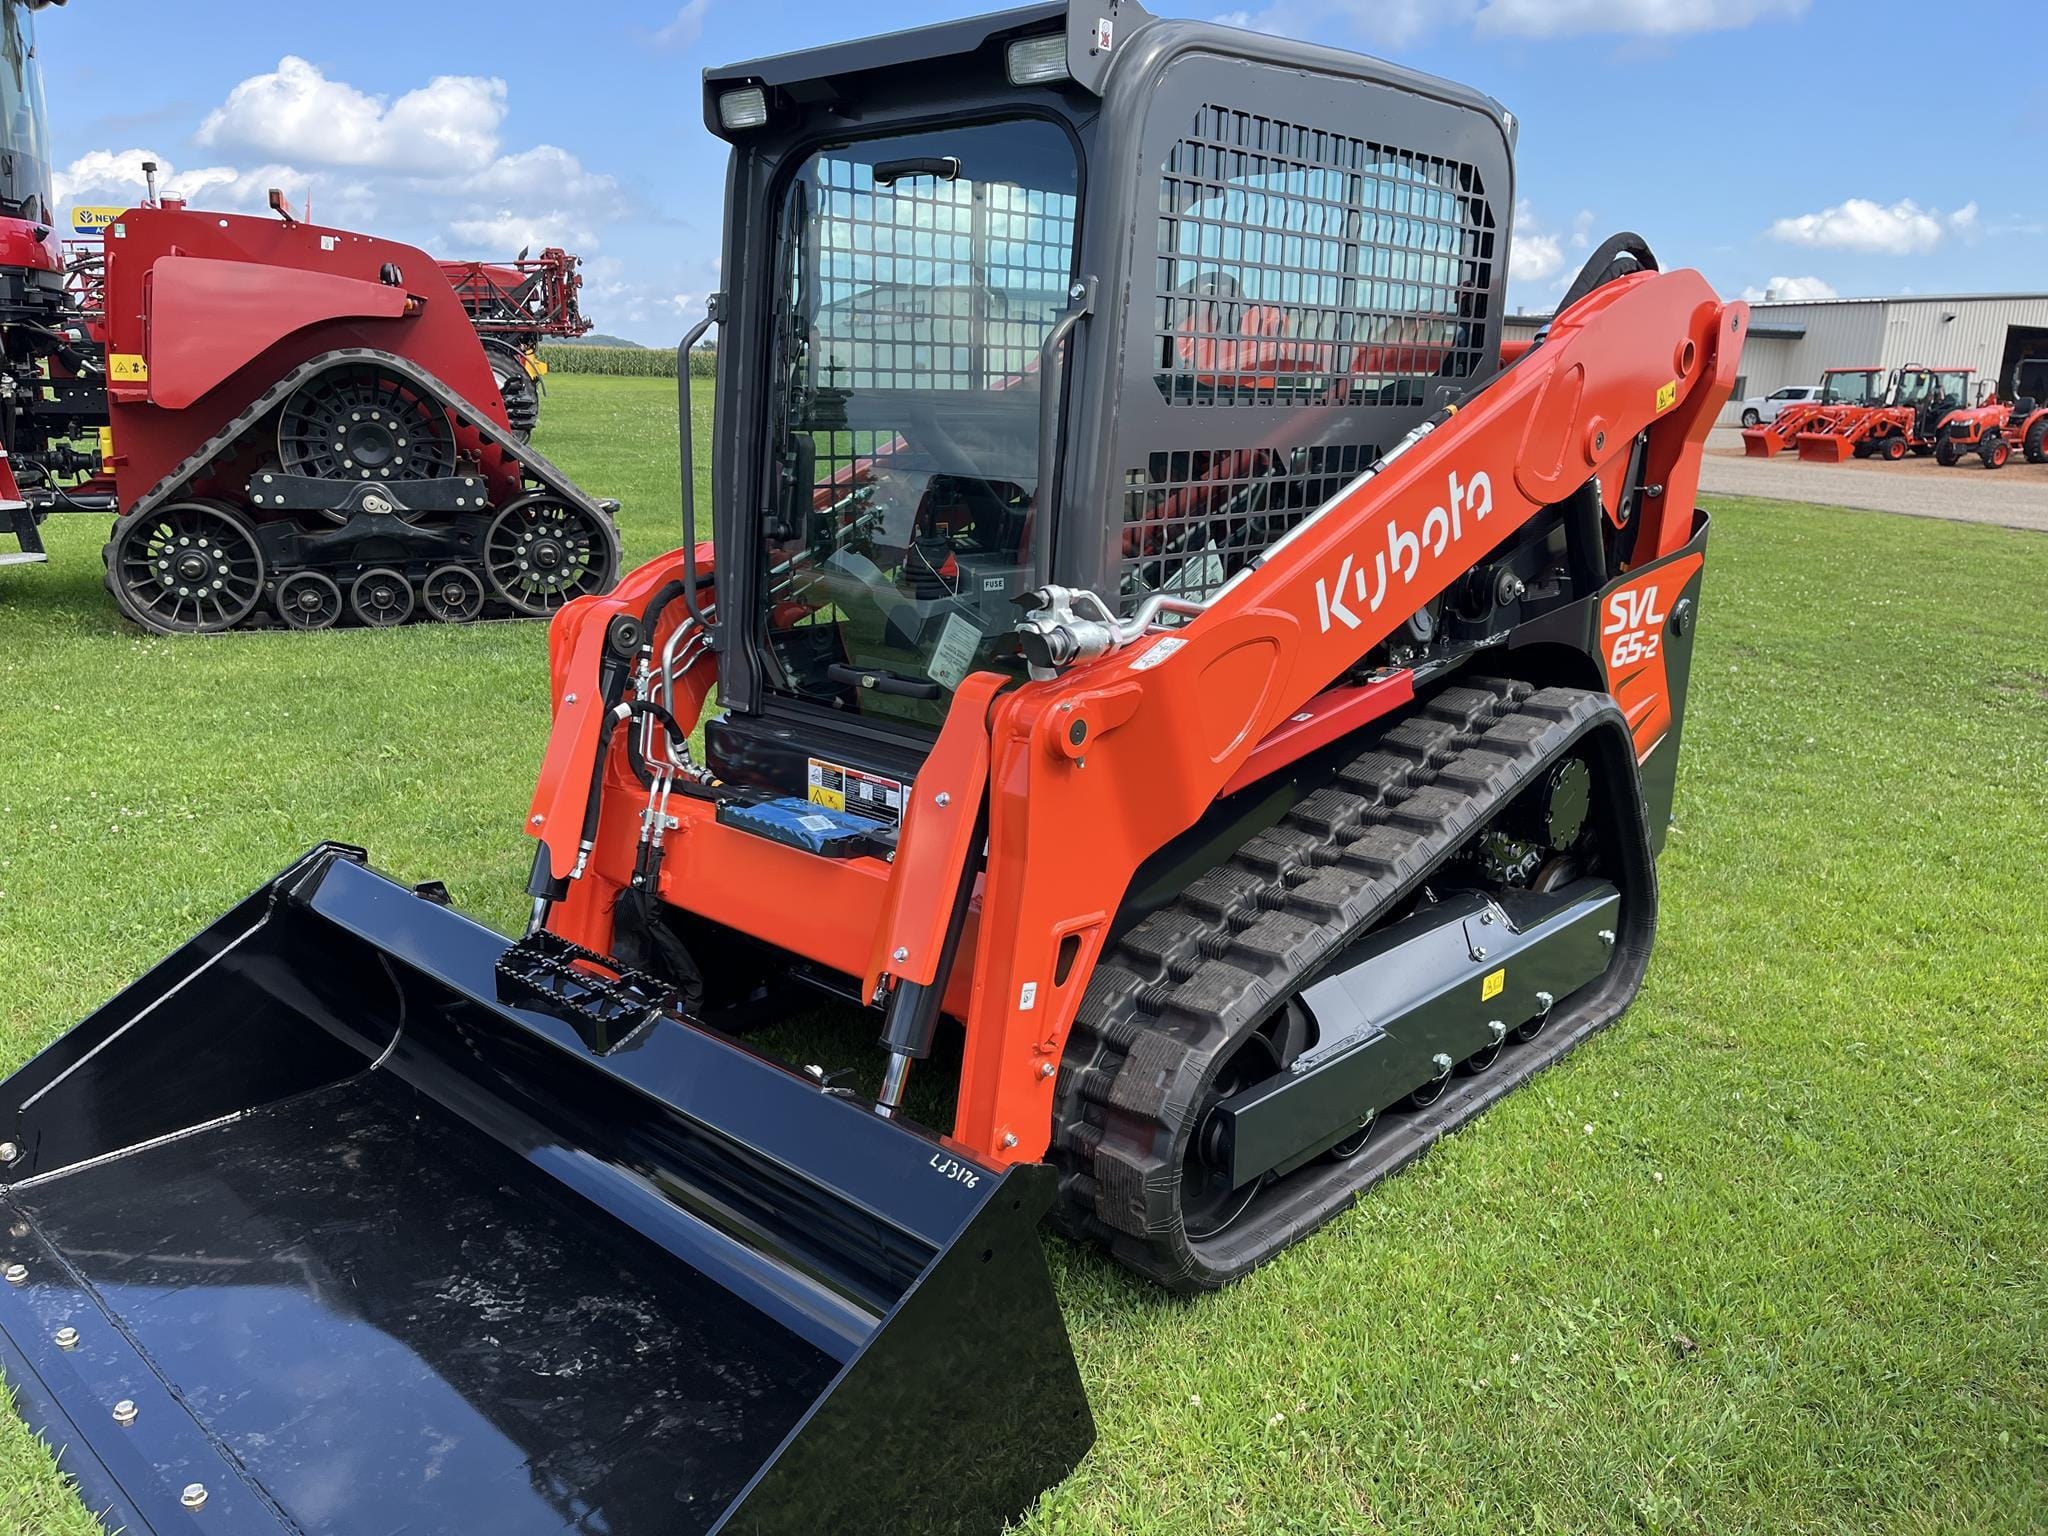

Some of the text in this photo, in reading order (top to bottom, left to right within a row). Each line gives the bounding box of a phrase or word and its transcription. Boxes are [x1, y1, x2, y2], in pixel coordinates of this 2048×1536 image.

[1315, 470, 1493, 633] Kubota
[985, 580, 1002, 588] FUSE
[1603, 585, 1664, 636] SVL
[1610, 630, 1659, 668] 65-2
